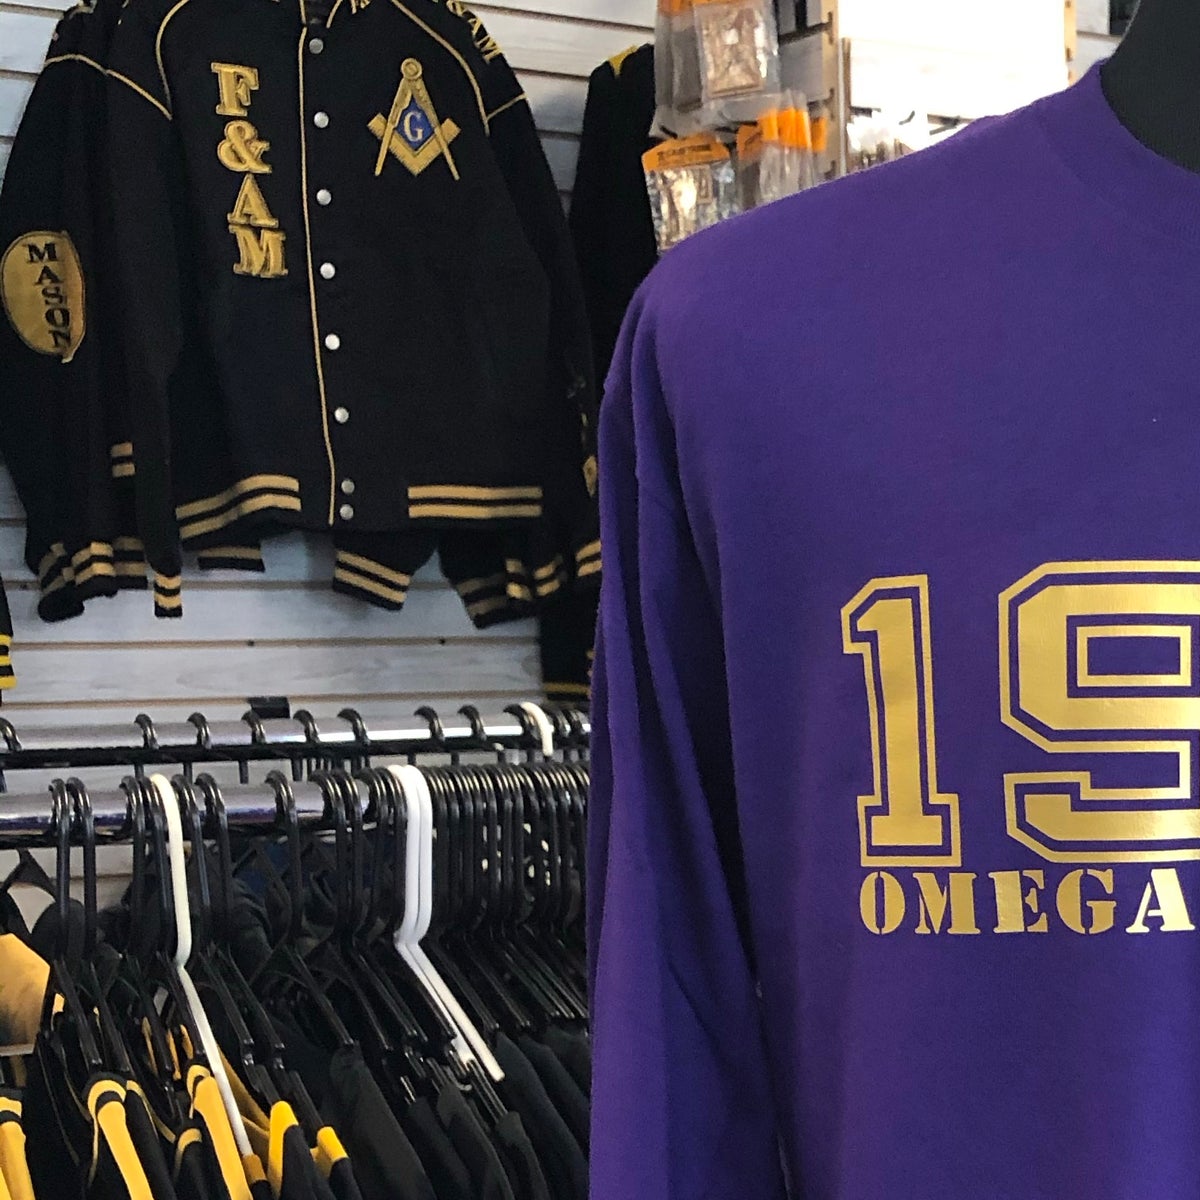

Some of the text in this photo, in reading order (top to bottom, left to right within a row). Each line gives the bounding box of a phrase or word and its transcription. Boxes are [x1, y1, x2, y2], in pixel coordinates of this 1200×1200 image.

[403, 111, 424, 142] G
[24, 242, 71, 348] MASON
[860, 868, 1195, 934] OMEGA
